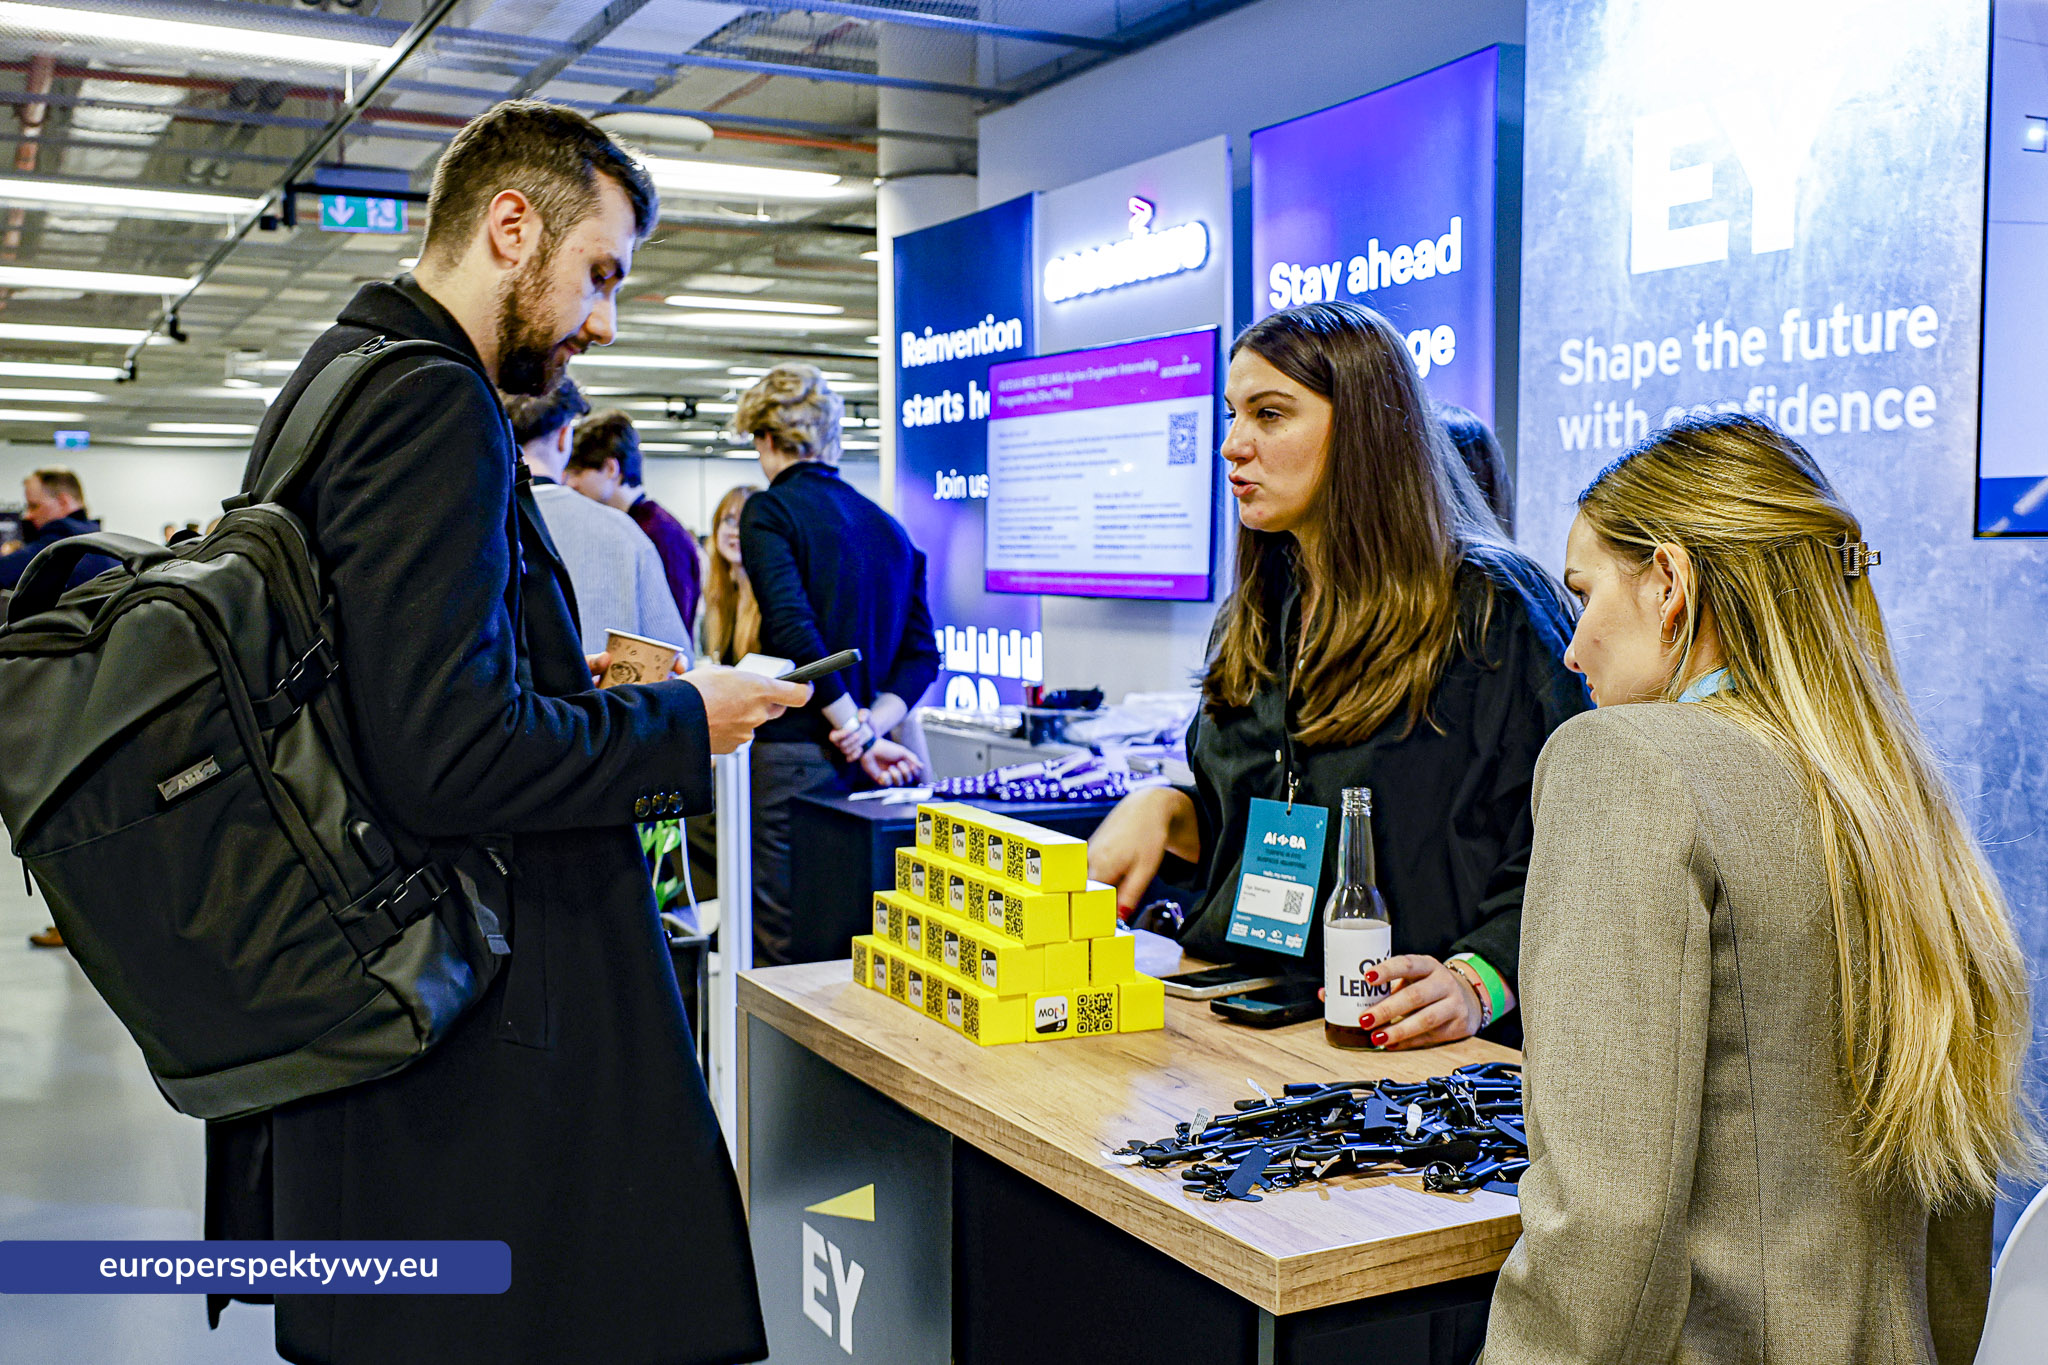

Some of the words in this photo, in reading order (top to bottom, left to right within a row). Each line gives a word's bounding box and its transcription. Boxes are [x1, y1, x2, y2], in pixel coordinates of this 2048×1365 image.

[1631, 70, 1842, 274] EY
[1268, 261, 1342, 310] Stay
[1347, 216, 1462, 295] ahead
[901, 313, 1023, 368] Reinvention
[1399, 324, 1456, 379] ge
[1559, 337, 1682, 389] Shape
[1692, 319, 1768, 371] the
[1780, 303, 1939, 362] future
[902, 389, 965, 428] starts
[1558, 398, 1649, 451] with
[933, 468, 967, 500] Join
[968, 473, 990, 499] us
[802, 1221, 865, 1356] EY
